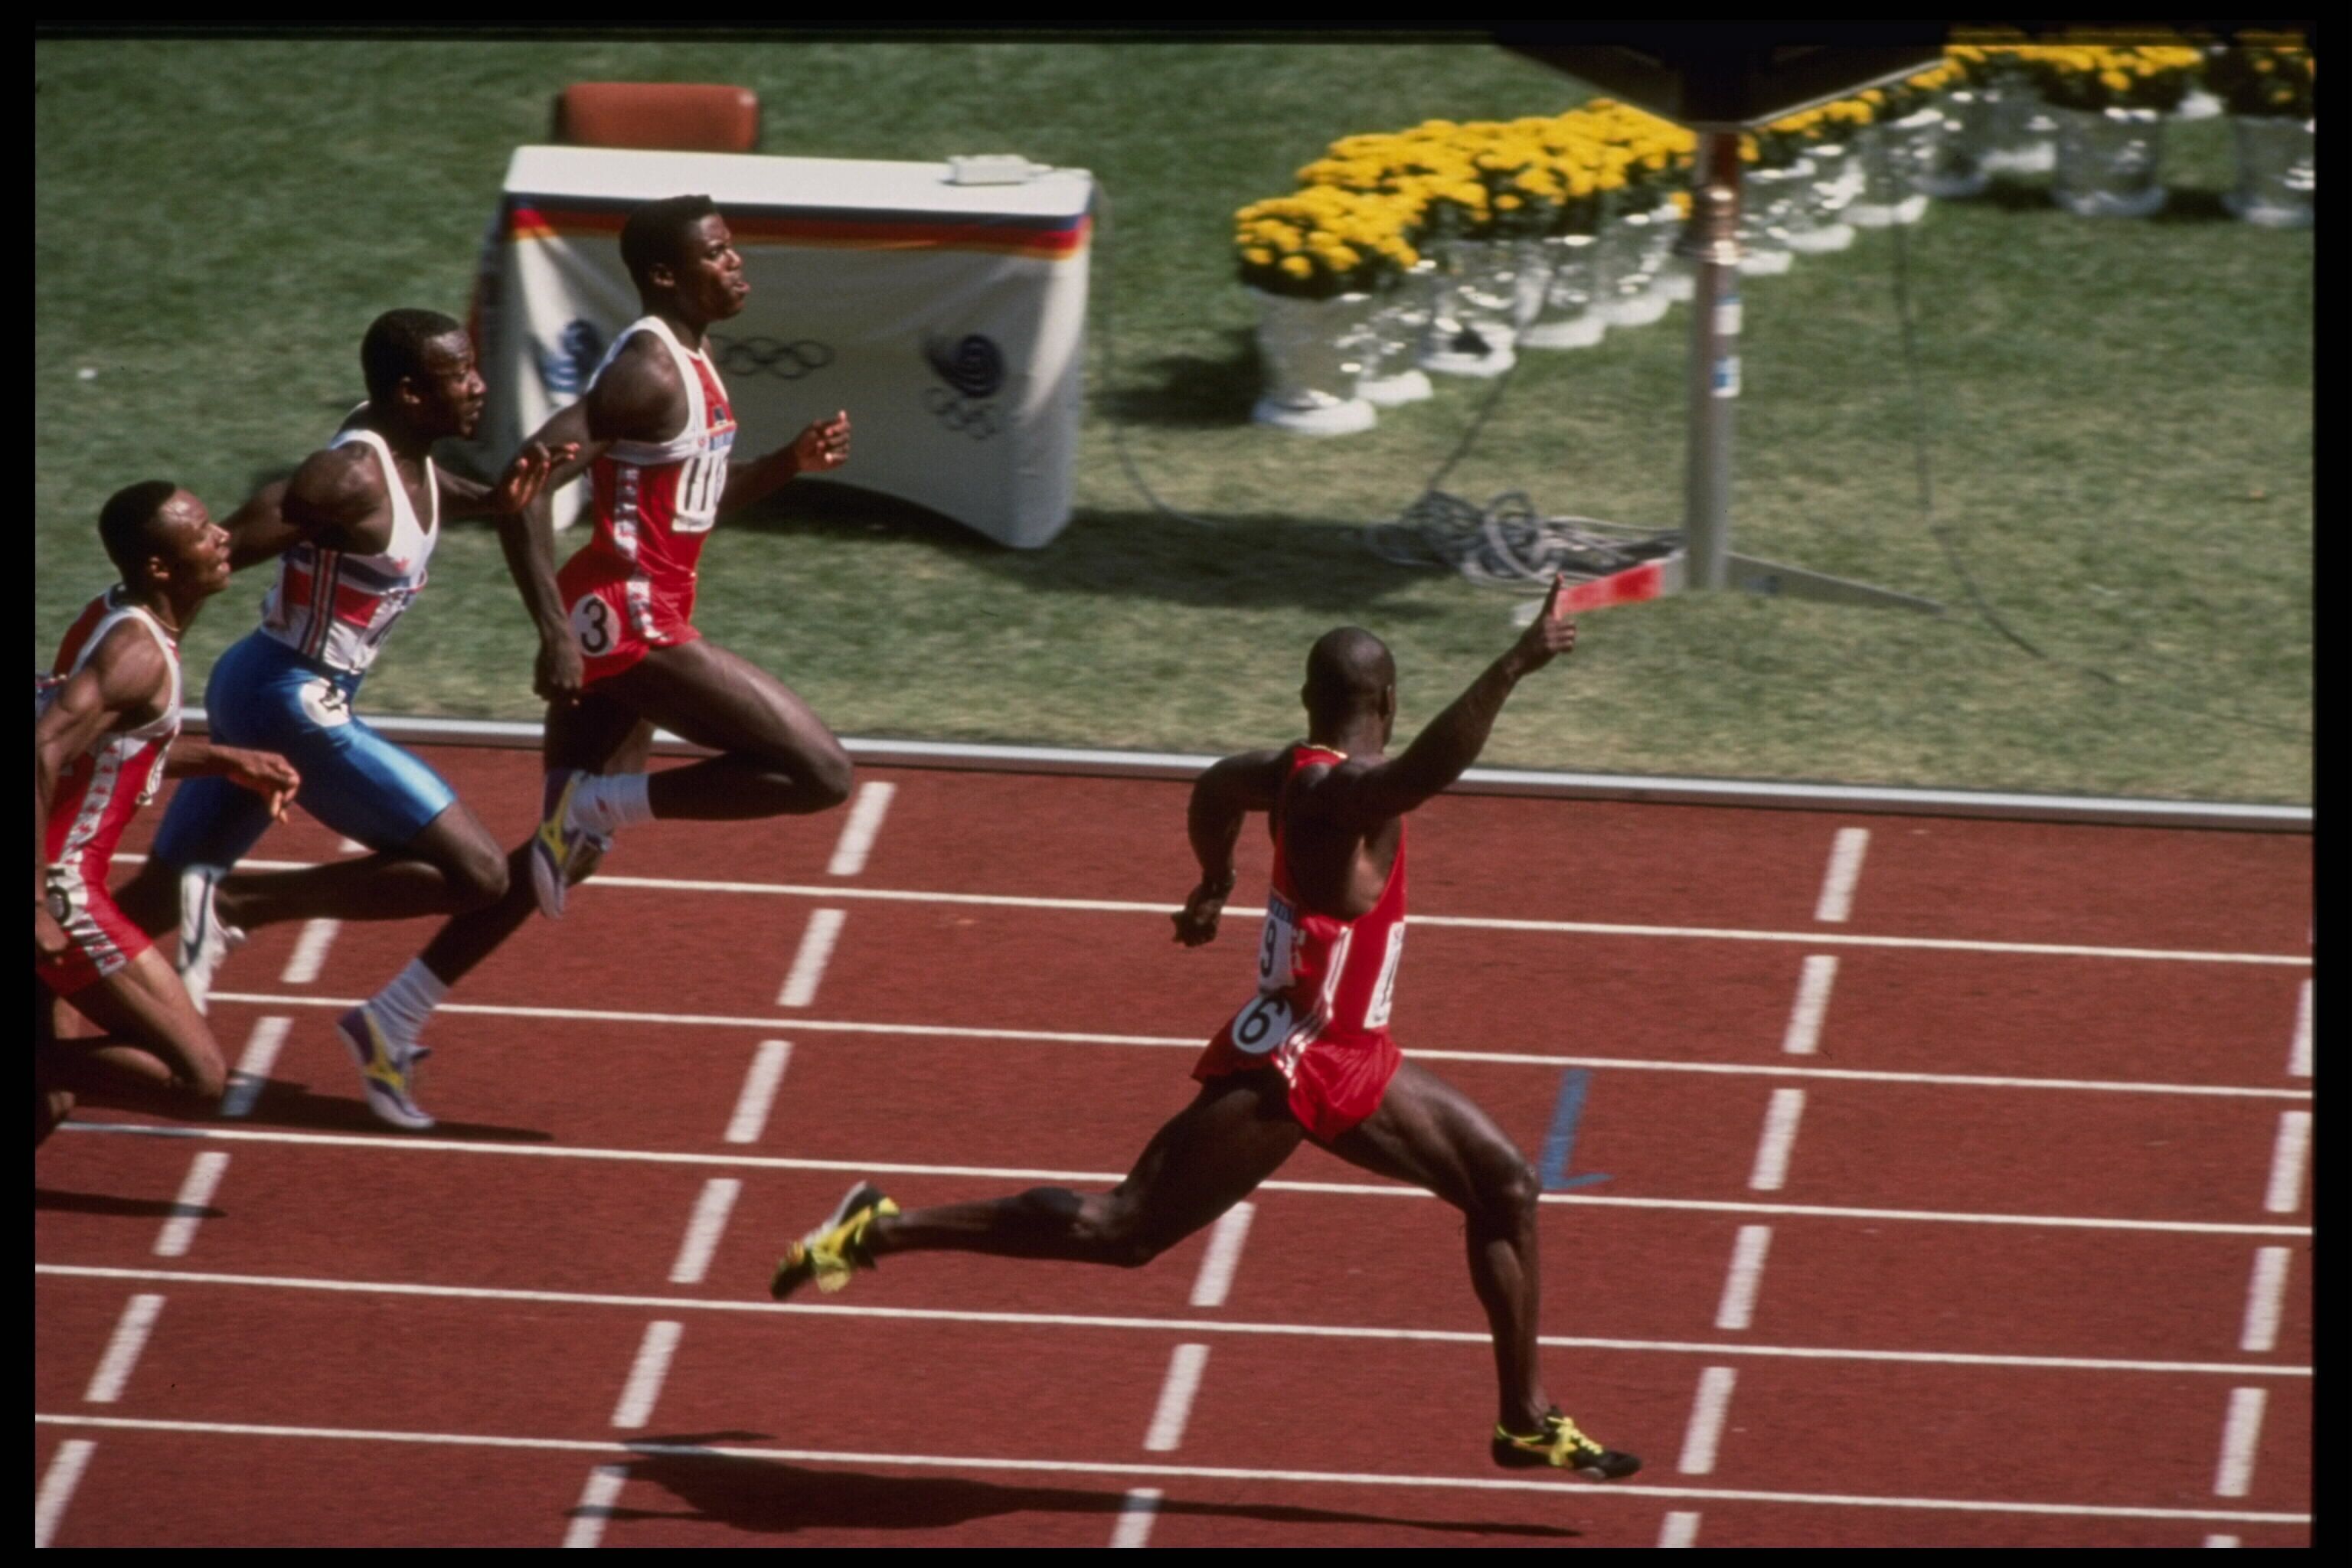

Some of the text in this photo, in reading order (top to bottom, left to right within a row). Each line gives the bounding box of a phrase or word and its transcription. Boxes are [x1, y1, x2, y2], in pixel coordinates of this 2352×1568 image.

[580, 596, 609, 654] 3
[1260, 917, 1277, 978] 9
[1237, 996, 1287, 1045] 6
